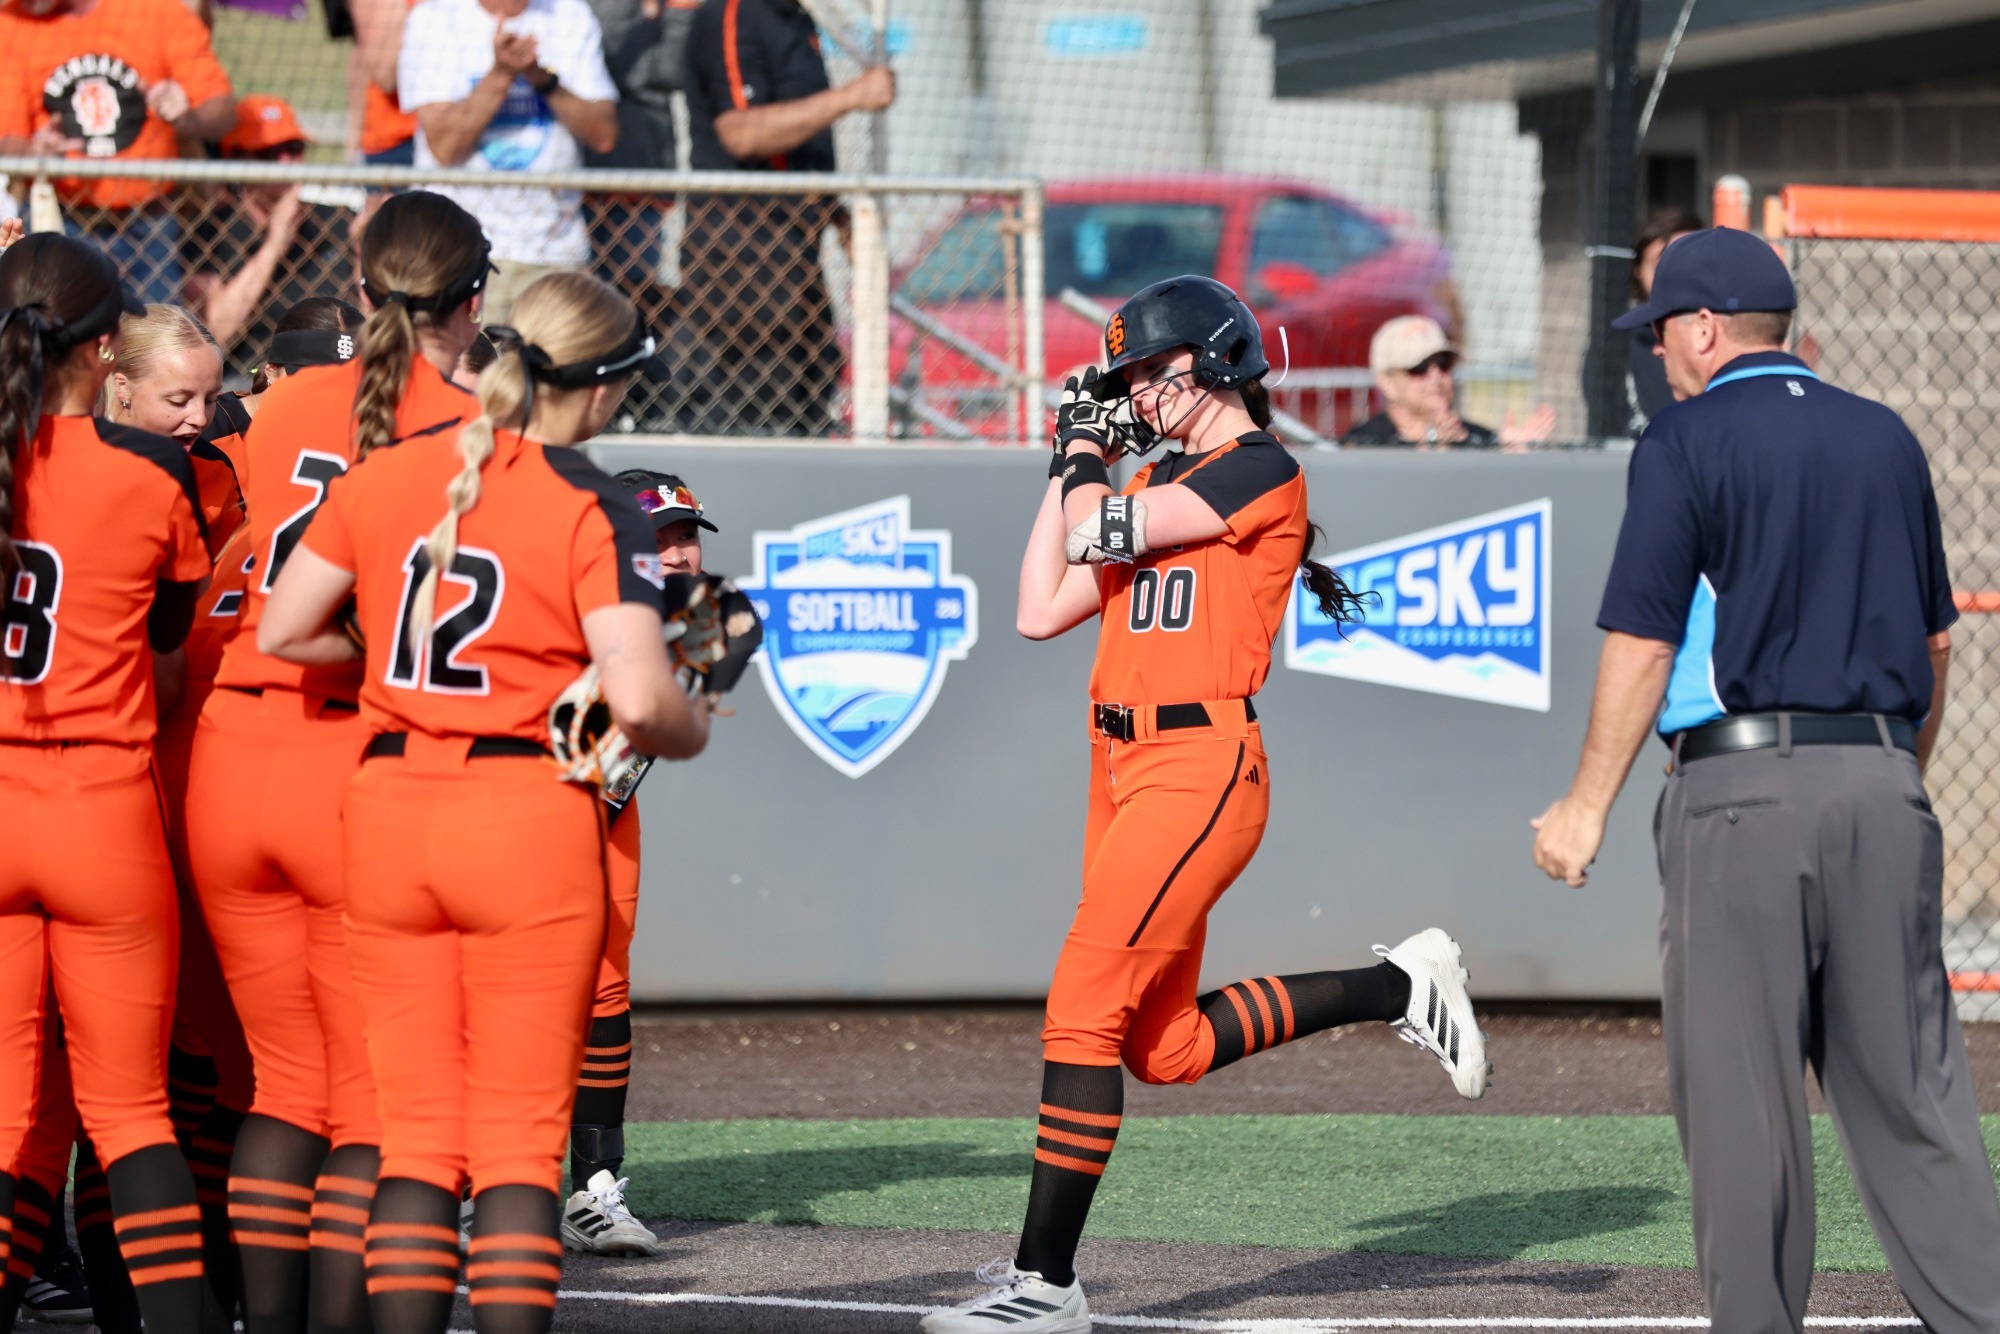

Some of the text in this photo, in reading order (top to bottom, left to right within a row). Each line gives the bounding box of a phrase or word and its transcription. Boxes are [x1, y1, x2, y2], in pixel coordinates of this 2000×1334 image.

[841, 514, 897, 557] SKY
[1109, 531, 1124, 549] 00
[1395, 521, 1537, 628] SKY
[384, 536, 506, 697] 12
[787, 590, 920, 632] SOFTBALL
[1129, 567, 1197, 634] 00
[1395, 625, 1536, 648] CONFERENCE
